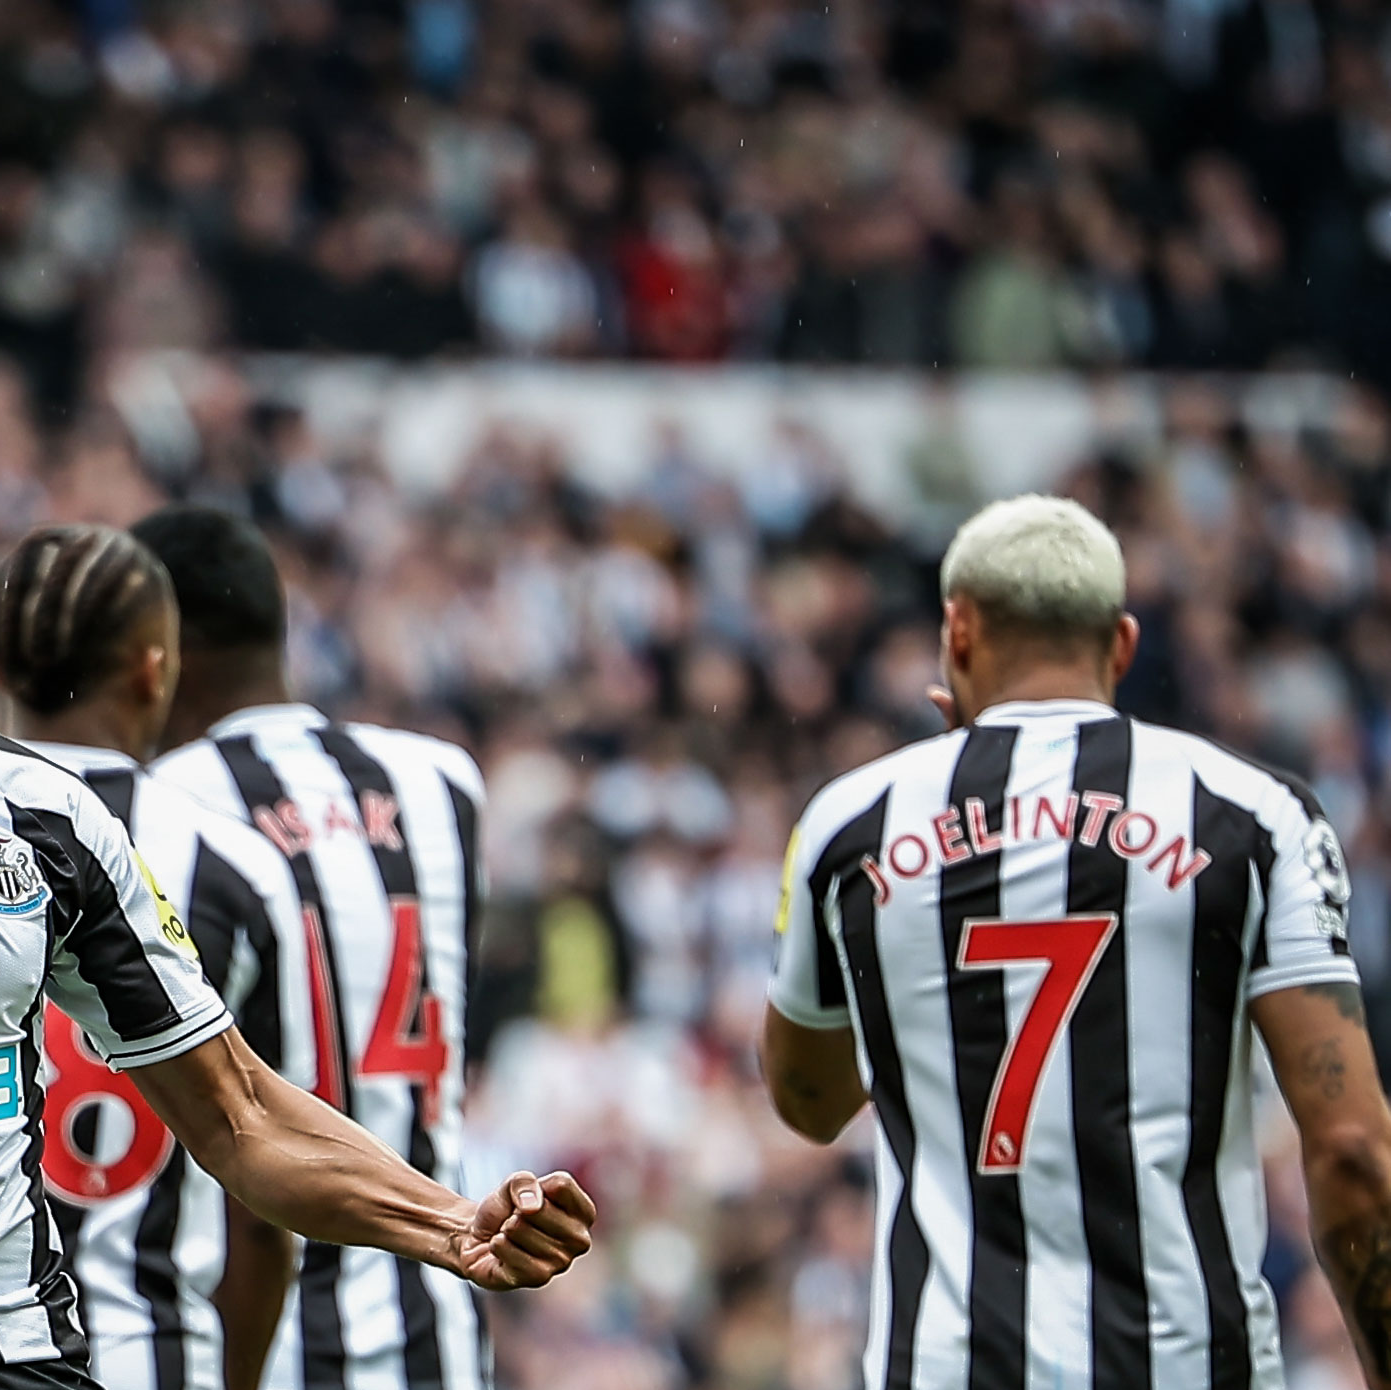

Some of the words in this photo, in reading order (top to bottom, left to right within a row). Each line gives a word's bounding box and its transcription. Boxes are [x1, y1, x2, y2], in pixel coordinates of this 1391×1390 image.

[253, 788, 403, 858] ISAK
[859, 790, 1212, 906] JOELINTON
[956, 911, 1119, 1174] 7
